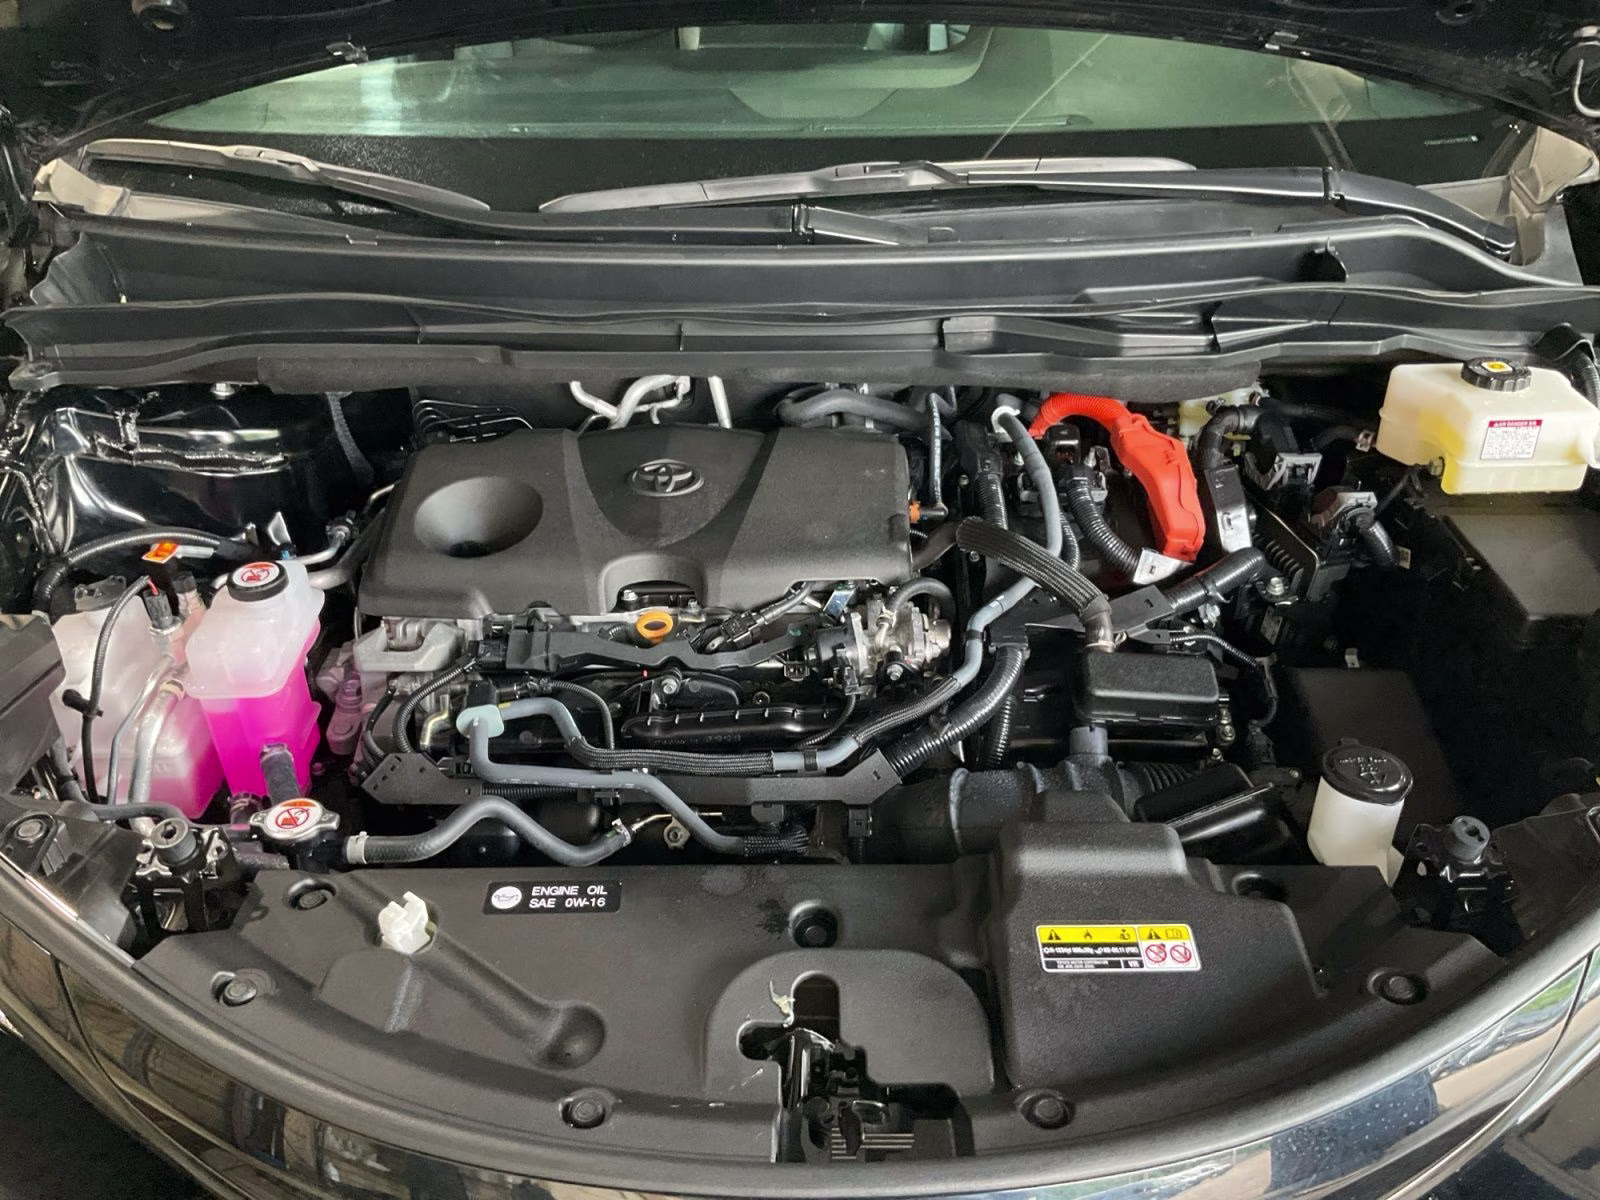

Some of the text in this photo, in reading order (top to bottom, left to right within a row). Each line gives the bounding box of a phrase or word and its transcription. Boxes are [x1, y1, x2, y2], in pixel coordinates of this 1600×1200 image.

[531, 885, 608, 895] ENGINE OIL
[529, 897, 606, 908] SAE 0W-16
